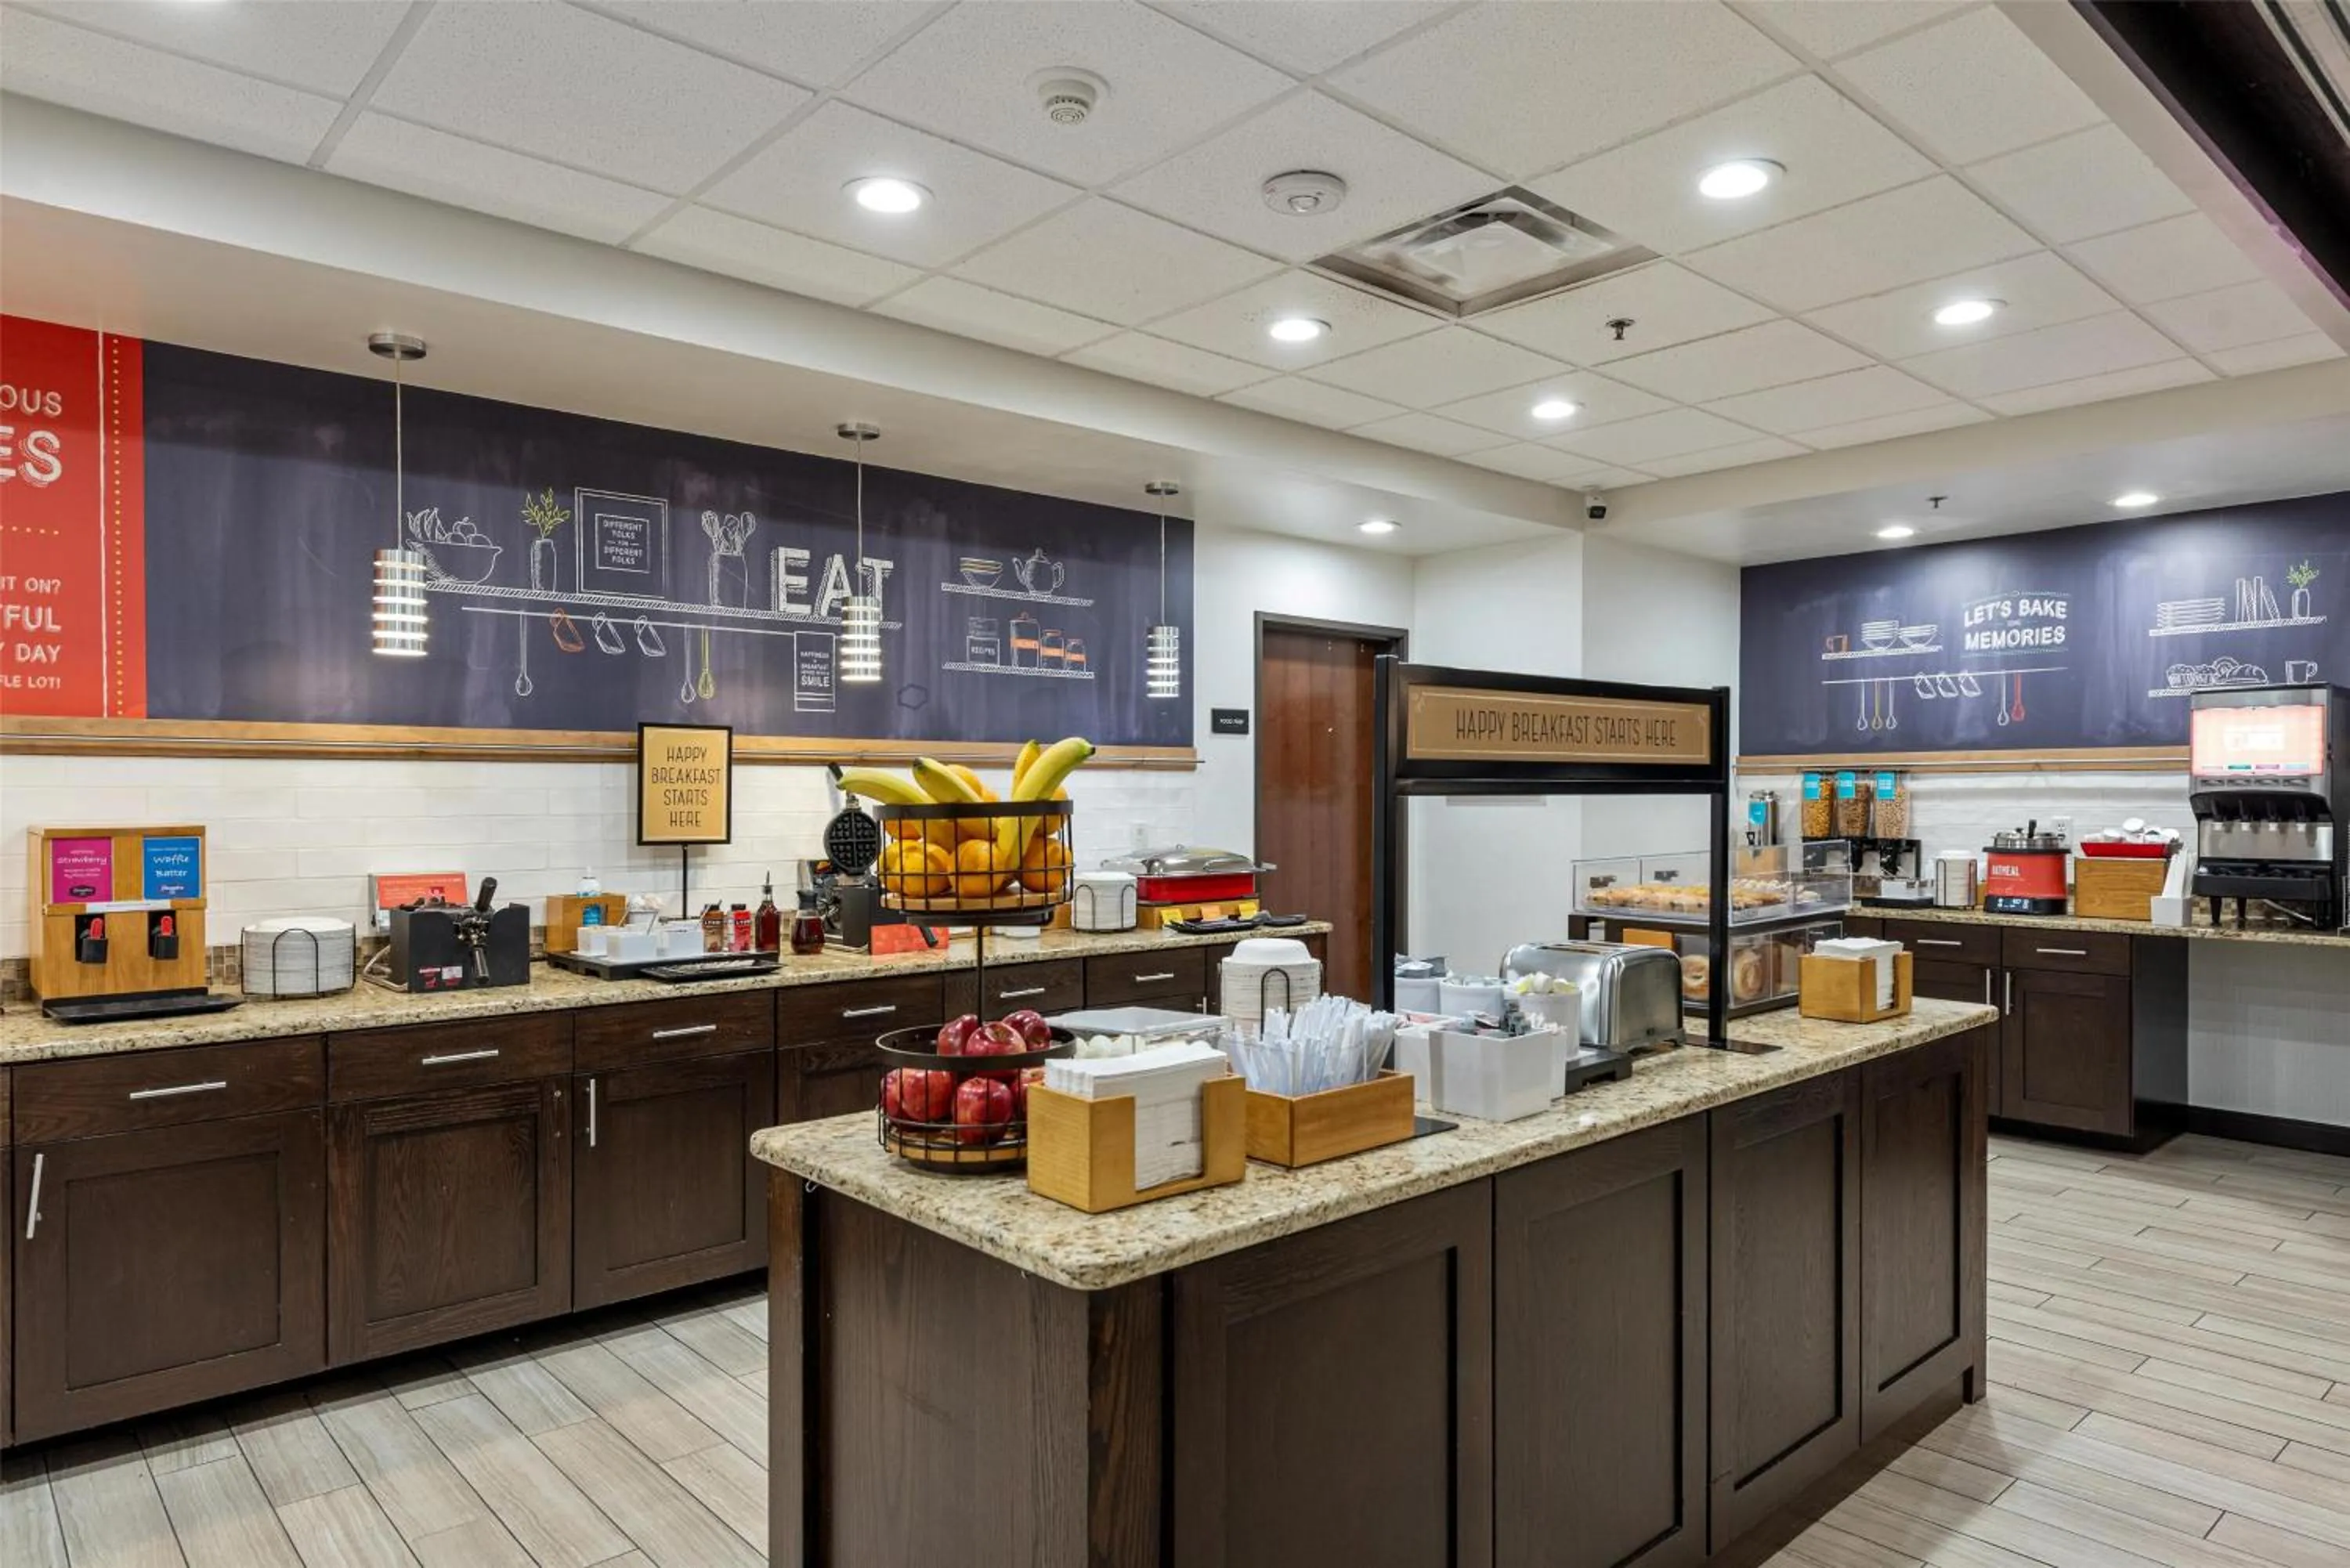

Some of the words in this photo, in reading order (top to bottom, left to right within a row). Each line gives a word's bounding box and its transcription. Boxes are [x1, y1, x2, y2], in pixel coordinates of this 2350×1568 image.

[25, 577, 61, 594] ON?
[771, 546, 894, 622] EAT
[0, 604, 62, 633] FUL
[1964, 600, 2012, 627] LET'S
[2018, 598, 2068, 619] BAKE
[1965, 625, 2066, 650] MEMORIES
[16, 643, 61, 663] DAY
[27, 677, 61, 688] LOT!
[801, 675, 830, 688] SMILE
[1455, 709, 1506, 740] HAPPY
[1511, 711, 1591, 745] BREAKFAST
[1594, 716, 1640, 746] STARTS
[1645, 718, 1676, 746] HERE
[666, 746, 707, 763] HAPPY
[651, 767, 721, 785] BREAKFAST
[663, 788, 708, 806] STARTS
[670, 811, 702, 828] HERE
